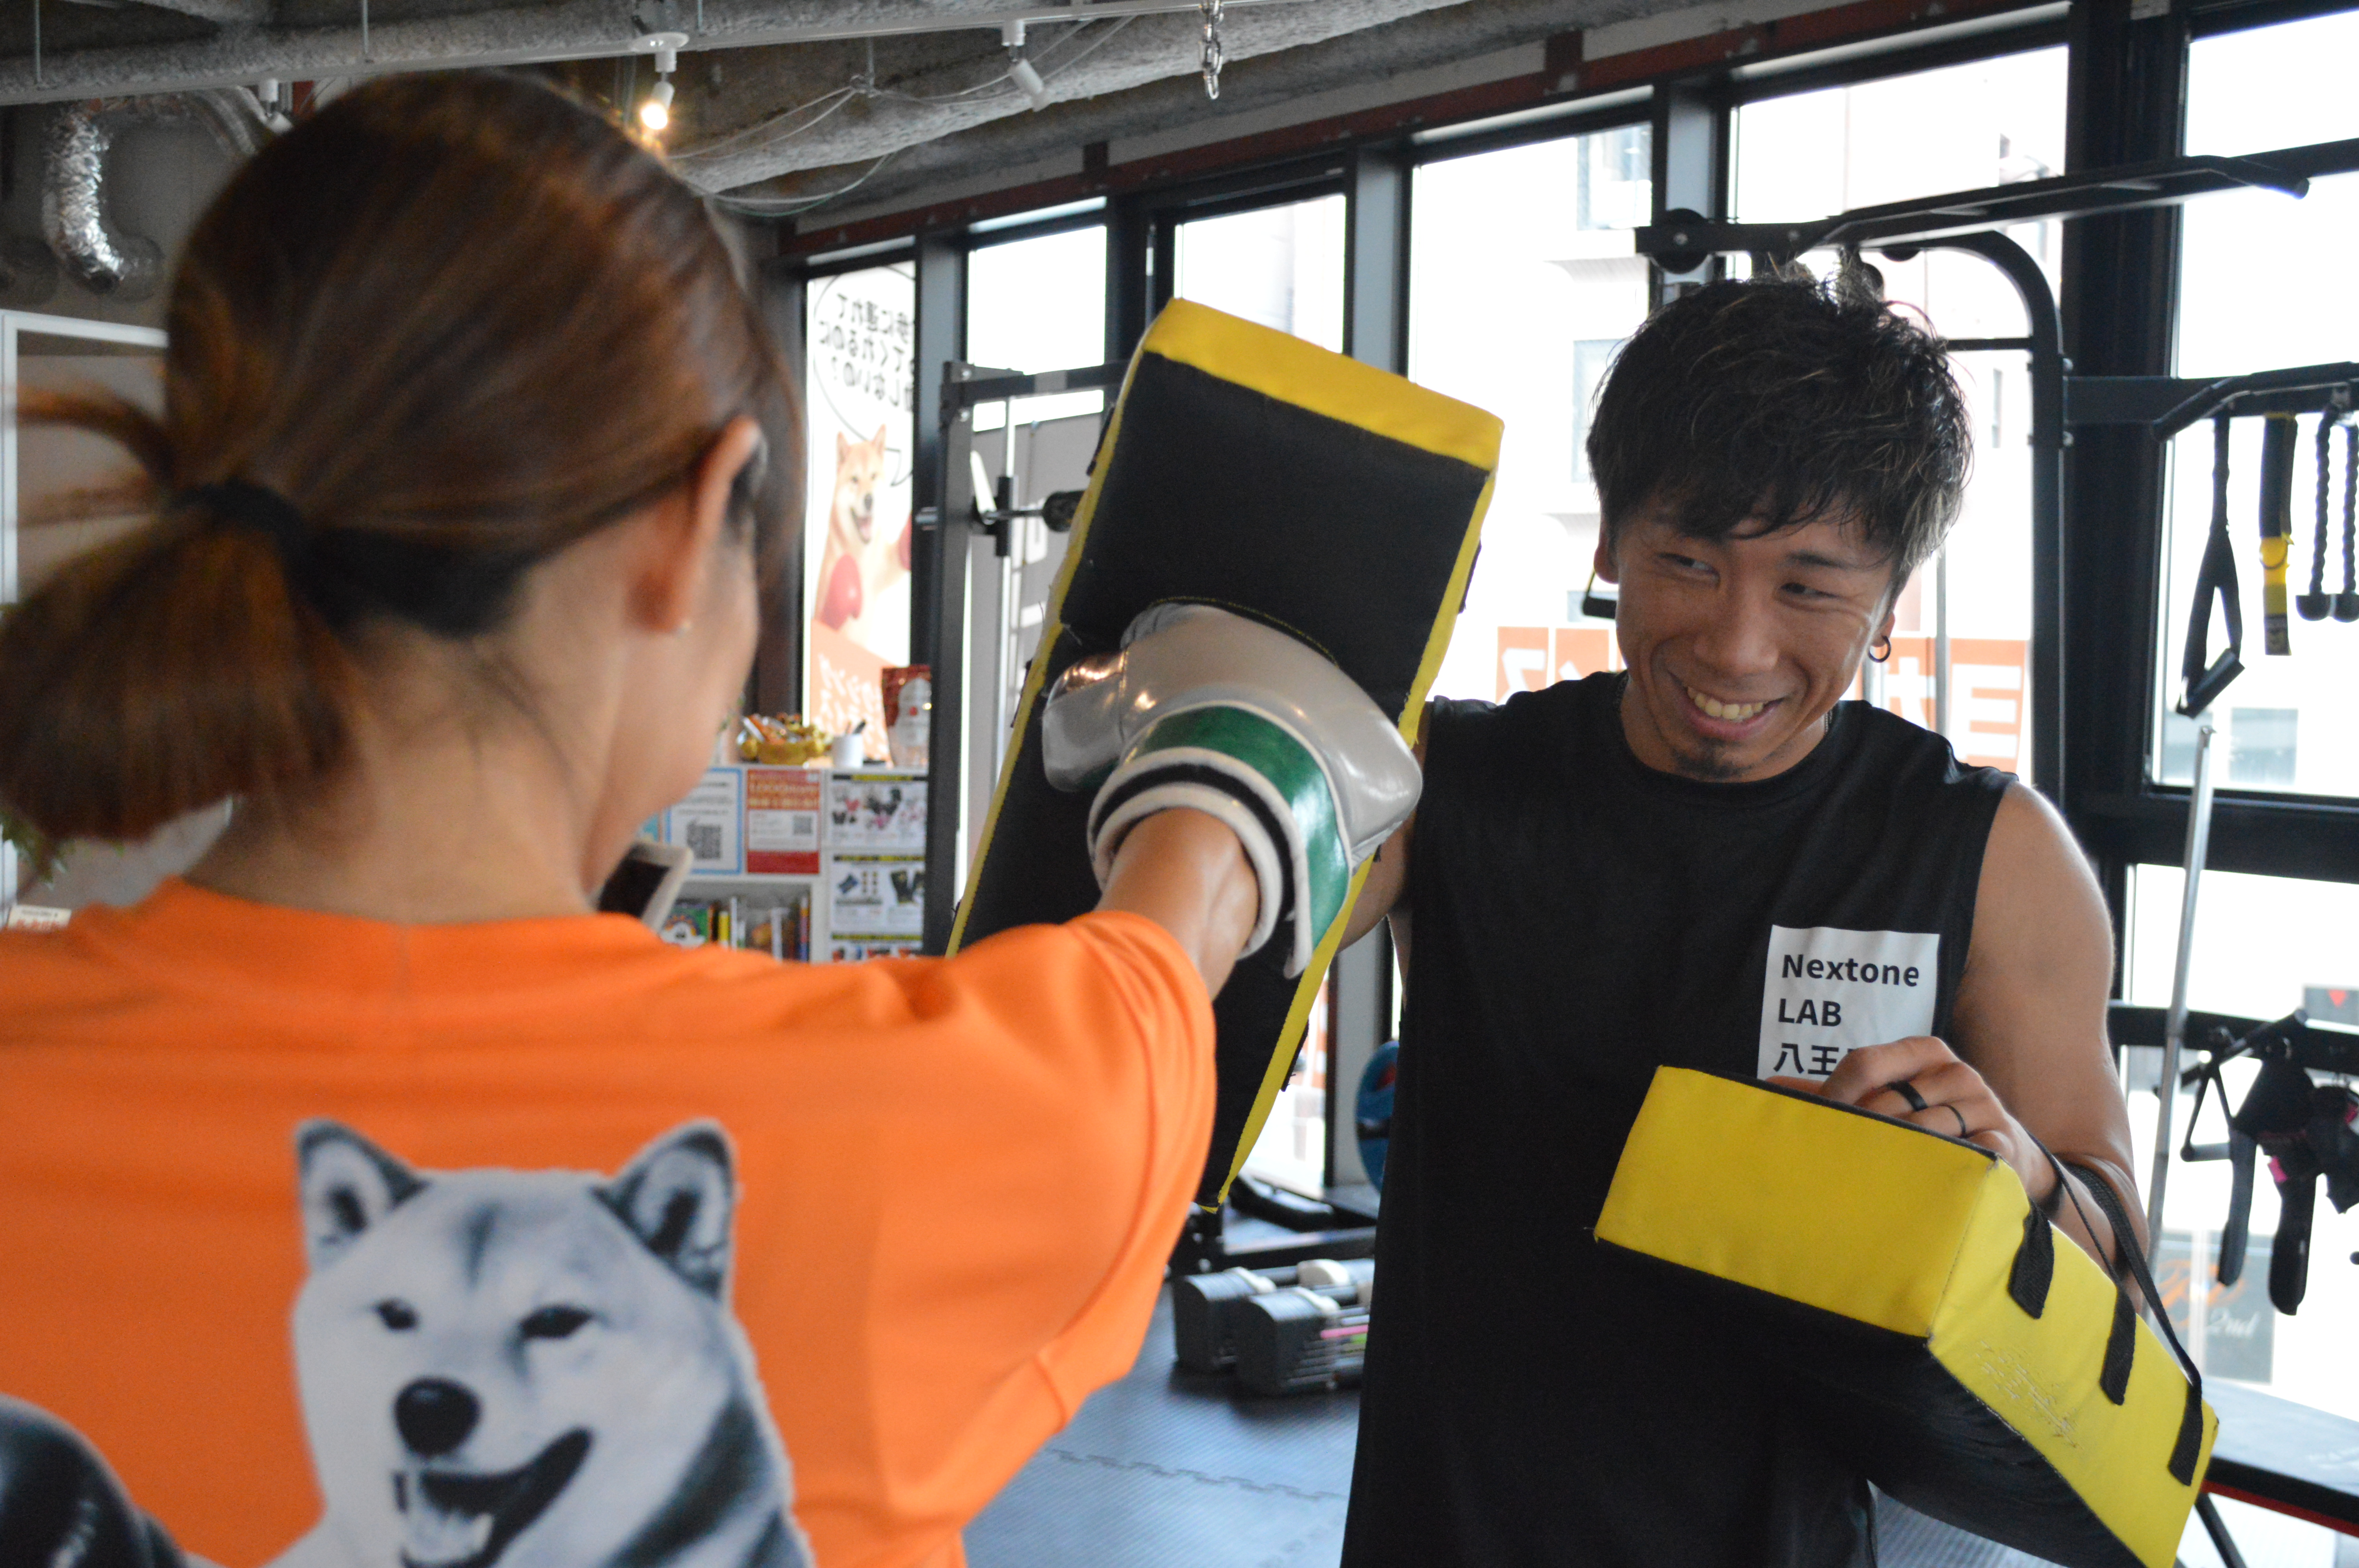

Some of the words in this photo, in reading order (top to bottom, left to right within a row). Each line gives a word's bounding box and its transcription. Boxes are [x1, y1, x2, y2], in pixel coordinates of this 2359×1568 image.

[1782, 954, 1919, 987] Nextone
[1777, 998, 1841, 1027] LAB
[1773, 1042, 1857, 1075] 八王
